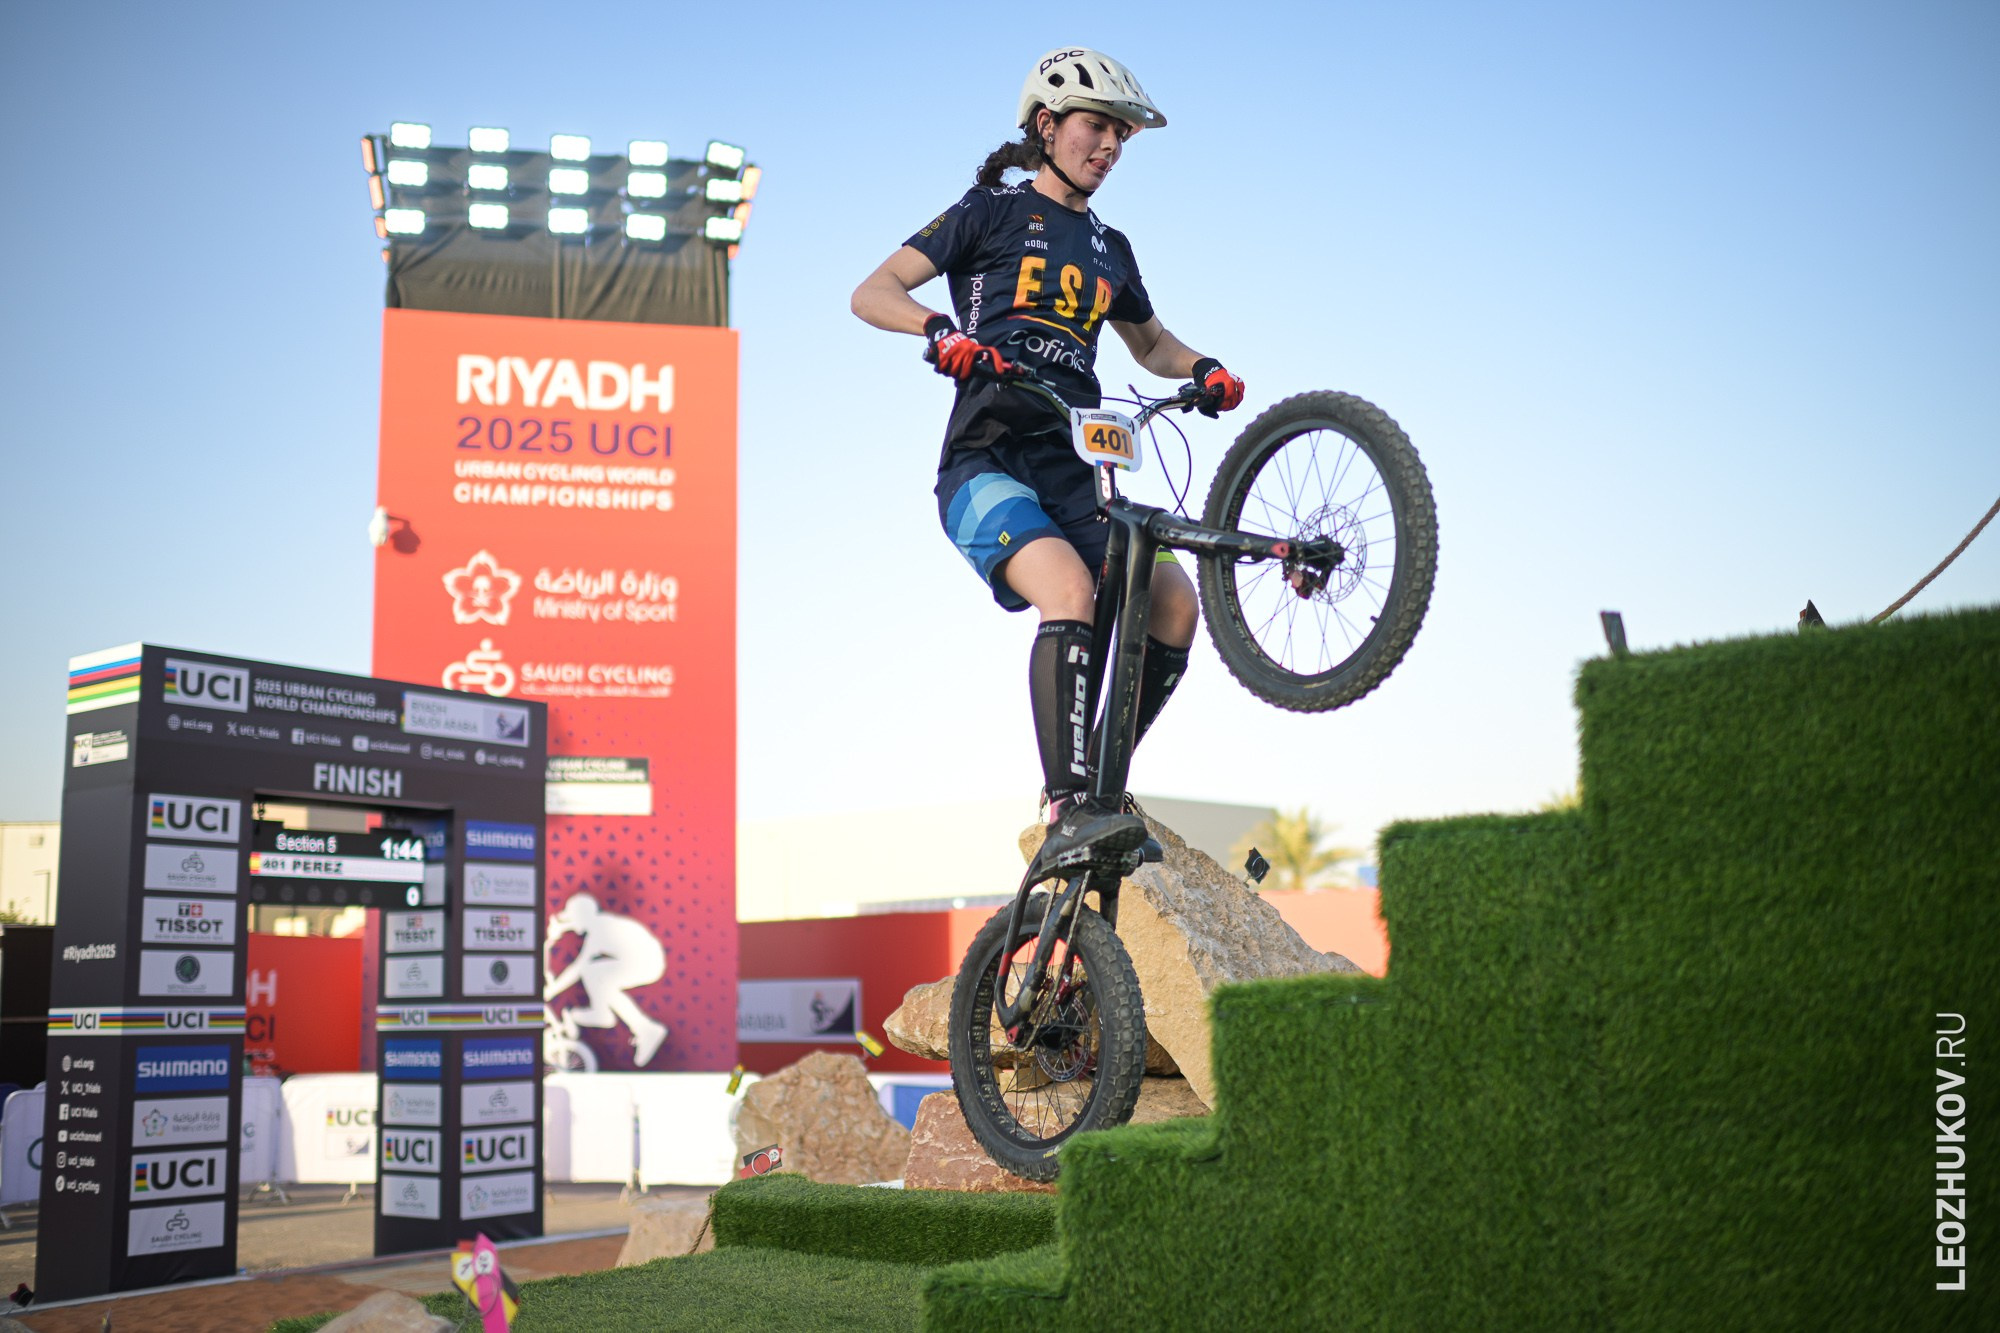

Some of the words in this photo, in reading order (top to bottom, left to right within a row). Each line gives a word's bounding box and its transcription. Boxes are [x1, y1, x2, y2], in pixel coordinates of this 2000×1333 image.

[1025, 240, 1049, 250] GOBIK
[1093, 257, 1111, 271] RALI
[1012, 255, 1112, 331] ESP
[456, 353, 676, 414] RIYADH
[456, 416, 574, 453] 2025
[590, 422, 673, 458] UCI
[1091, 428, 1129, 454] 401
[454, 460, 522, 481] URBAN
[522, 462, 605, 484] CYCLING
[606, 467, 676, 487] WORLD
[453, 482, 674, 511] CHAMPIONSHIPS
[533, 596, 600, 623] Ministry
[602, 598, 624, 621] of
[625, 600, 678, 624] Sport
[520, 663, 583, 683] SAUDI
[588, 665, 675, 685] CYCLING
[180, 669, 242, 704] UCI
[254, 678, 282, 695] 2025
[284, 681, 325, 700] URBAN
[326, 687, 377, 707] CYCLING
[254, 694, 299, 712] WORLD
[300, 701, 397, 725] CHAMPIONSHIPS
[313, 762, 402, 798] FINISH
[167, 802, 230, 833] UCI
[275, 833, 325, 852] Section
[380, 837, 424, 861] 1:44
[465, 829, 535, 850] SHIMANO
[262, 860, 286, 870] 401
[292, 859, 344, 875] PEREZ
[405, 885, 420, 906] 0
[155, 917, 224, 934] TISSOT
[394, 928, 436, 944] TISSOT
[474, 928, 526, 941] TISSOT
[63, 943, 117, 963] #Riyadh2025
[73, 1013, 97, 1030] UCI
[166, 1012, 204, 1029] UCI
[400, 1009, 425, 1025] UCI
[484, 1008, 513, 1024] UCI
[246, 1014, 275, 1042] CI
[73, 1057, 95, 1072] uci.org
[137, 1058, 228, 1078] SHIMANO
[384, 1051, 441, 1067] SHIMANO
[463, 1048, 534, 1068] SHIMANO
[394, 1137, 433, 1164] UCI
[477, 1135, 526, 1163] UCI
[151, 1158, 216, 1191] UCI
